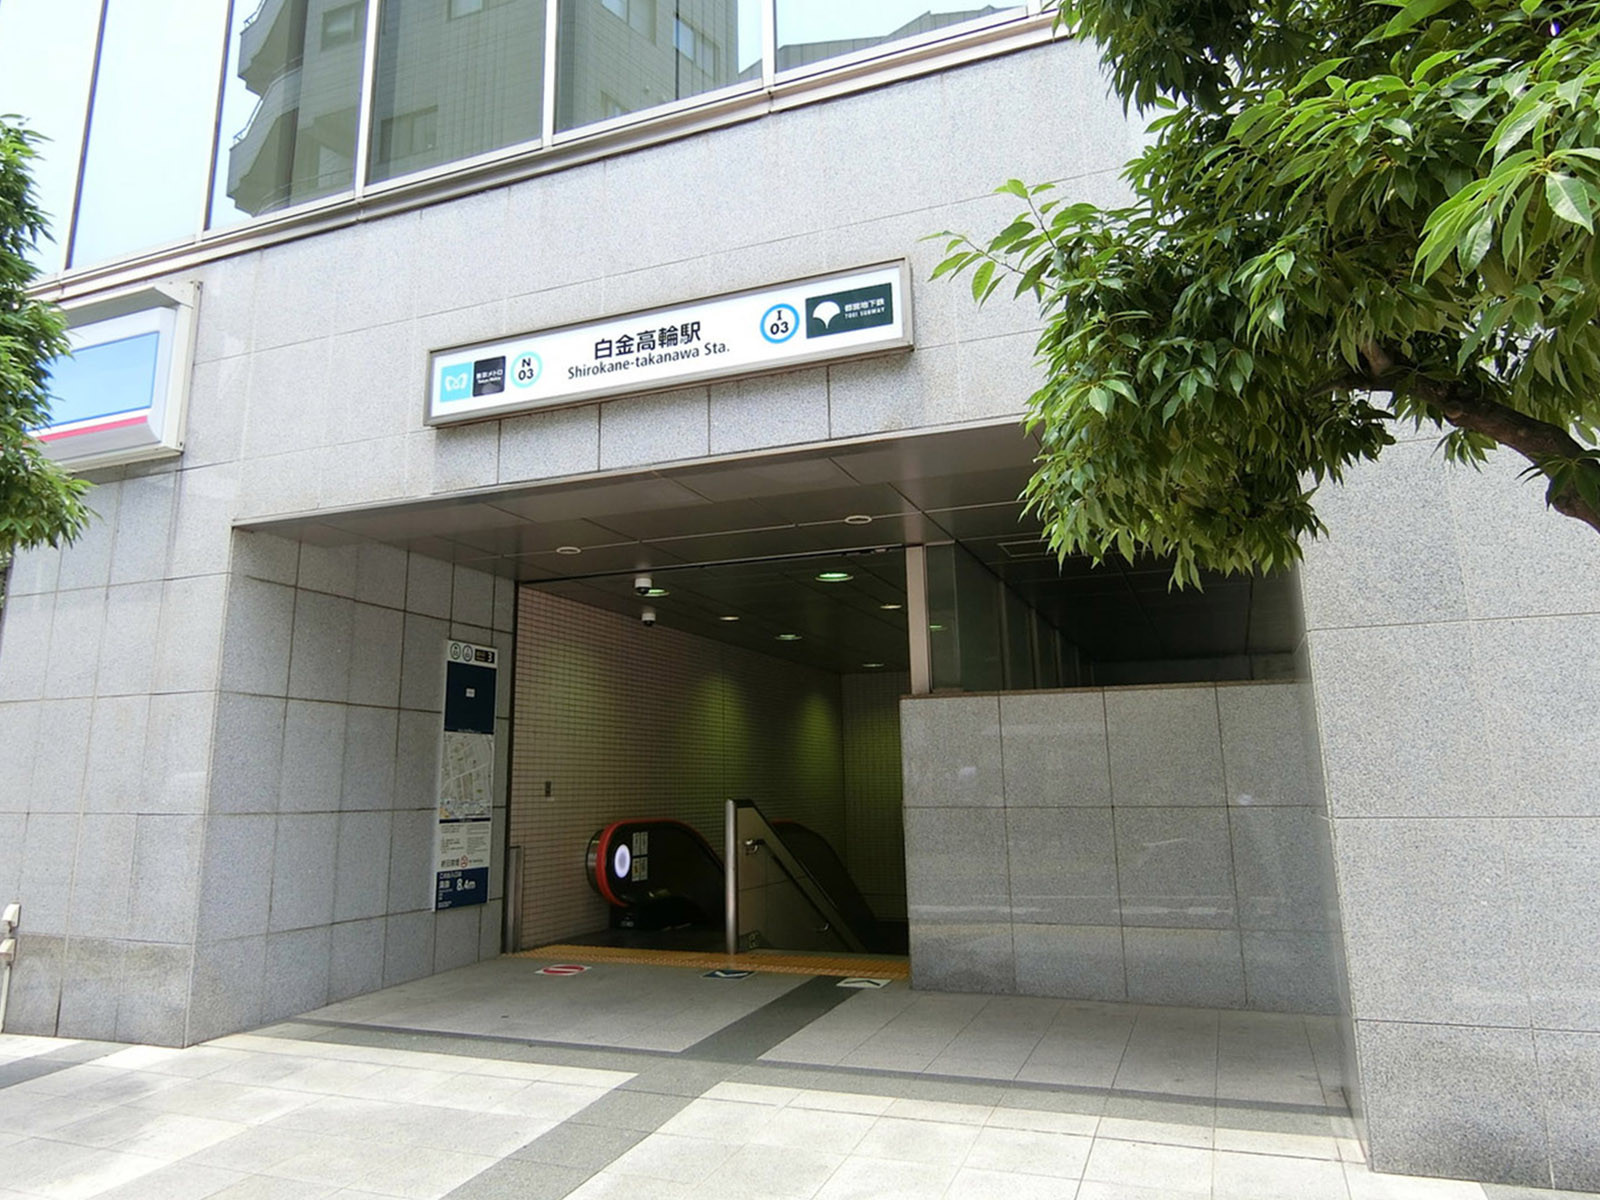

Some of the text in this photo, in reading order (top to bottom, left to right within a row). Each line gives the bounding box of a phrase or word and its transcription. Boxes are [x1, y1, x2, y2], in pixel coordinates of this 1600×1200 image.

[776, 310, 783, 321] I
[770, 321, 789, 335] 03
[594, 321, 702, 360] 白金高輪駅
[522, 357, 532, 368] N
[568, 341, 730, 380] Shirokane-takanawa Sta.
[518, 368, 534, 381] 03
[487, 651, 493, 662] 3
